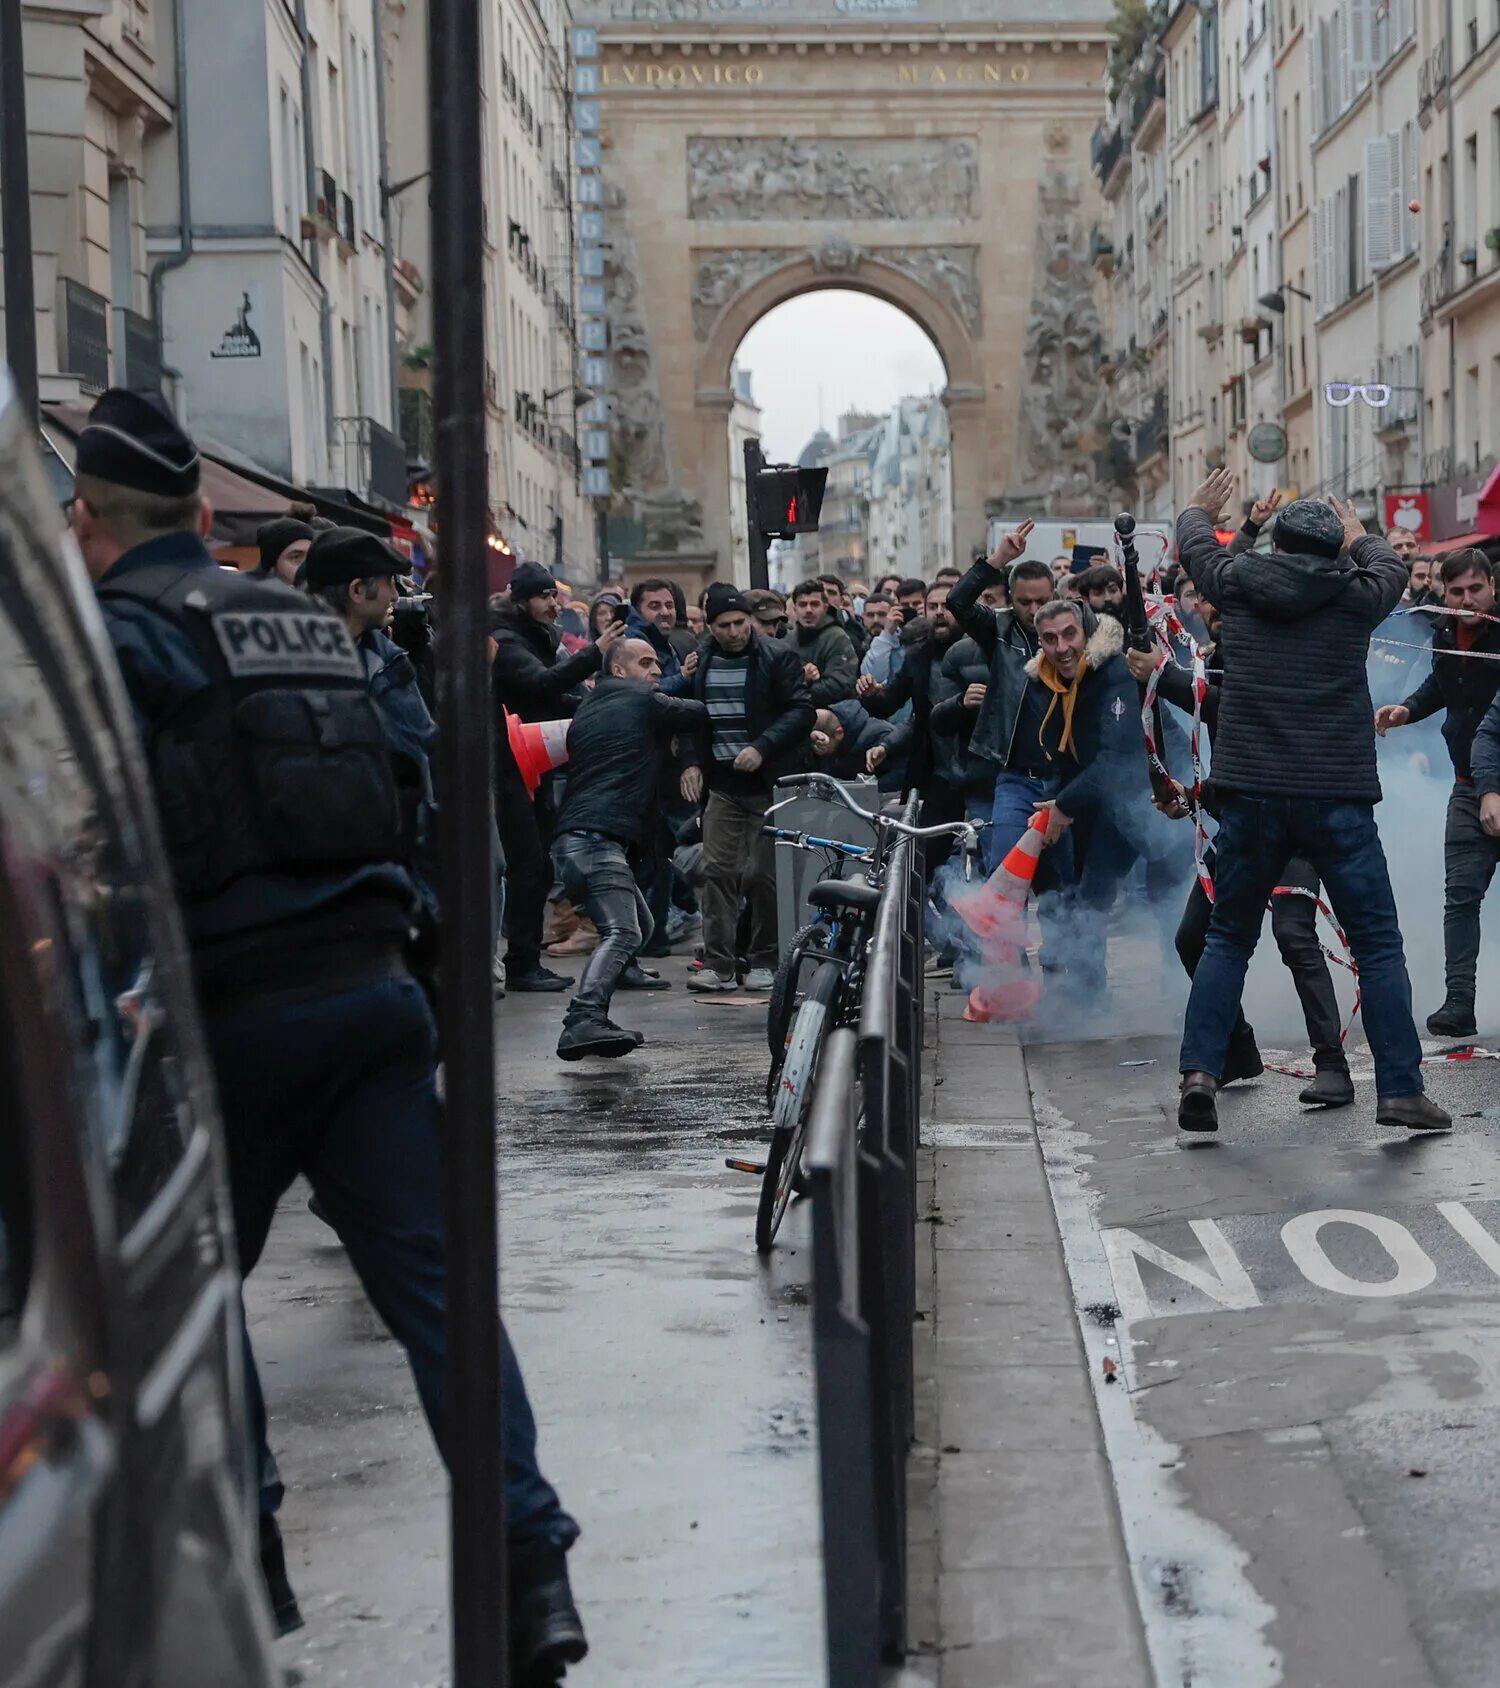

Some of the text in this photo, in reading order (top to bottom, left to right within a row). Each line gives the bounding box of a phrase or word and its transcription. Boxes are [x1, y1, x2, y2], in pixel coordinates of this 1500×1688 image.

[602, 63, 1032, 85] LVDOVICO MAGNO
[576, 30, 603, 273] PASSAGE
[222, 616, 353, 658] POLICE
